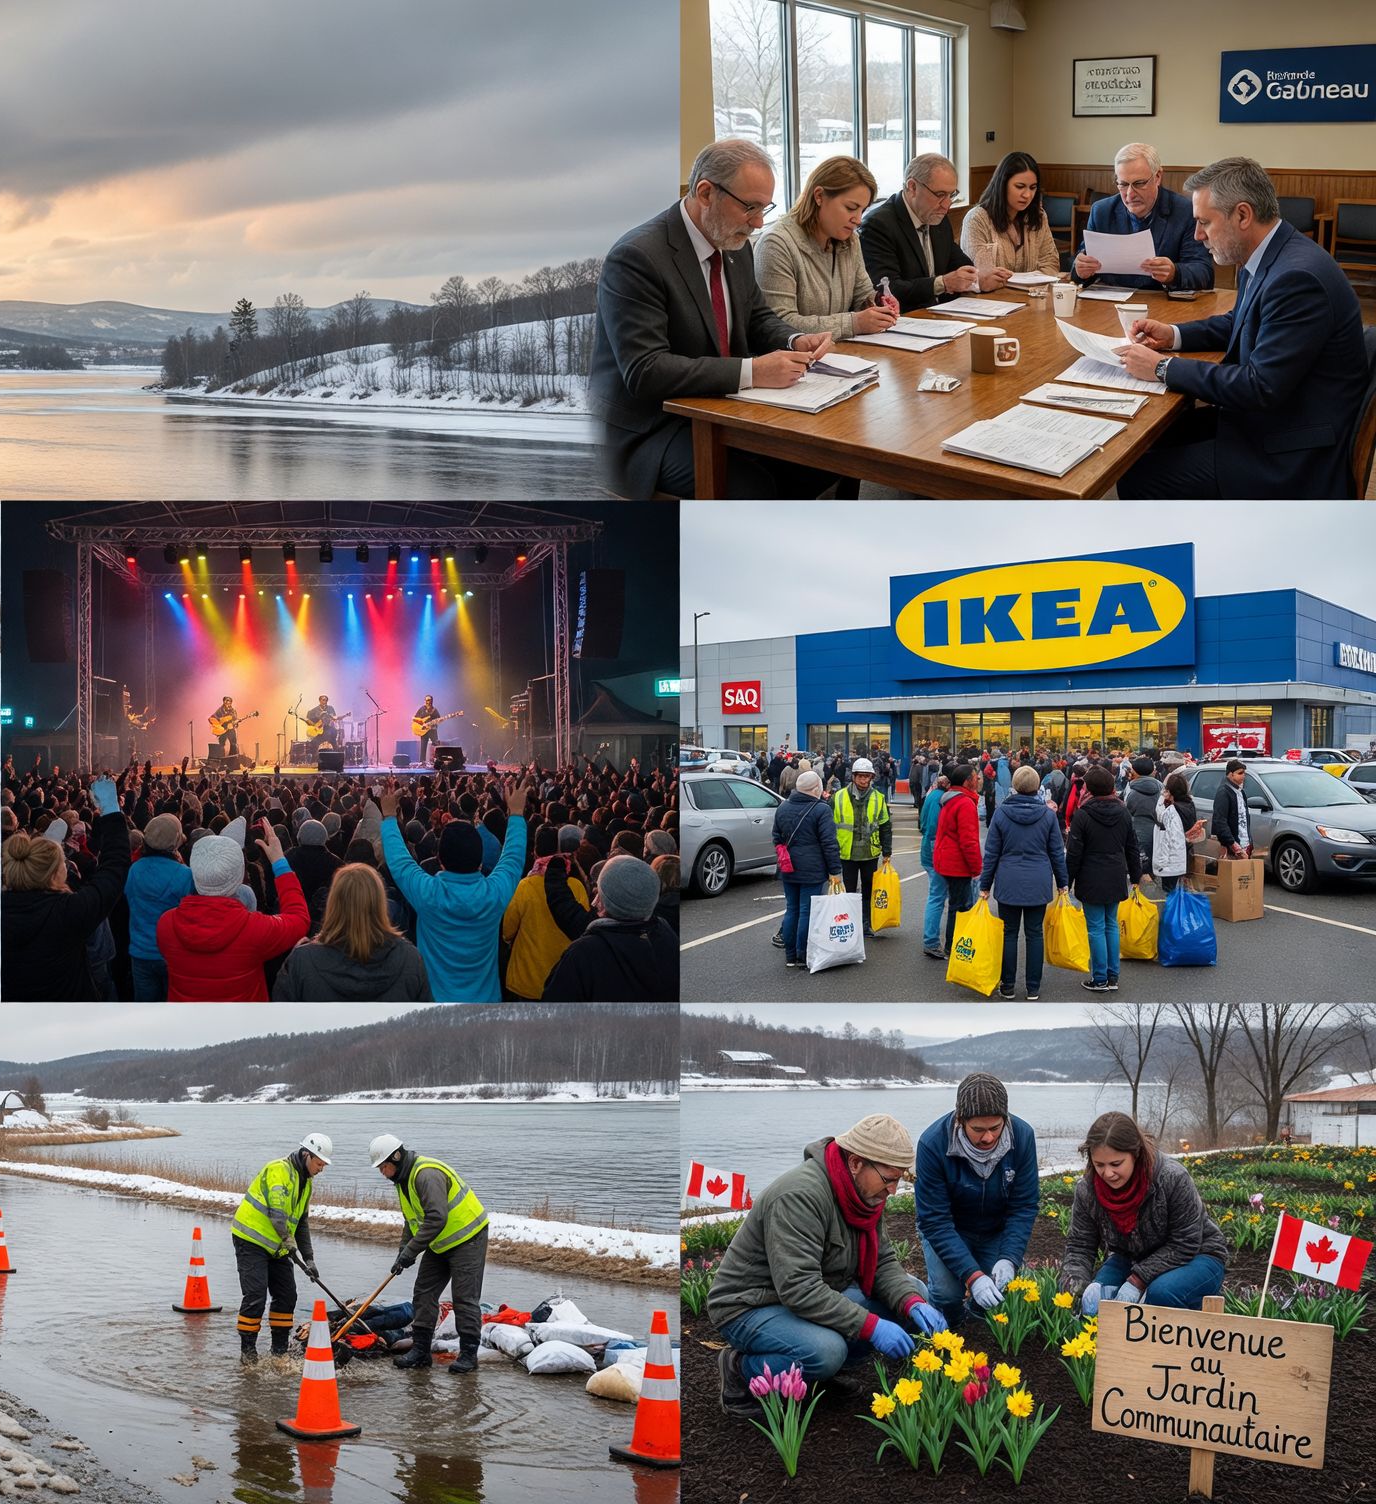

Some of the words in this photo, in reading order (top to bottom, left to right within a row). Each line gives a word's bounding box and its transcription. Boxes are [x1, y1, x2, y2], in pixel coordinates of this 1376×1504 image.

[923, 582, 1162, 648] IKEA
[724, 688, 759, 708] SAQ
[1124, 1304, 1287, 1359] Bienvenue
[1146, 1364, 1260, 1416] Jardin
[1190, 1356, 1225, 1376] au
[1101, 1386, 1314, 1460] Communautaire
